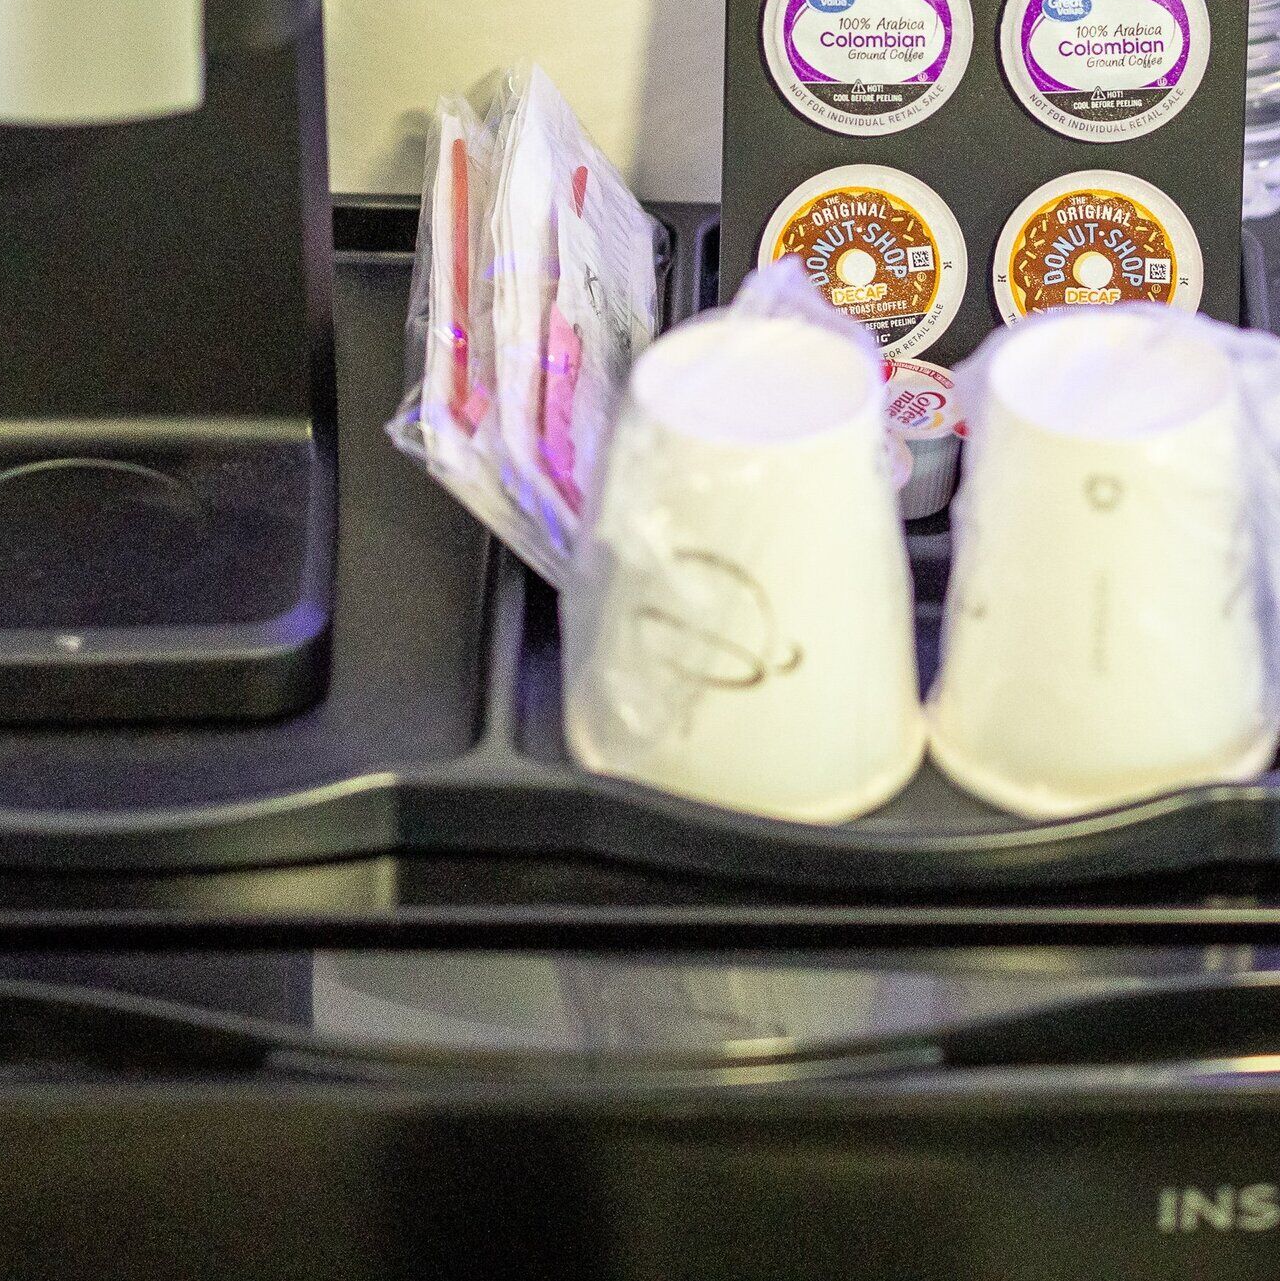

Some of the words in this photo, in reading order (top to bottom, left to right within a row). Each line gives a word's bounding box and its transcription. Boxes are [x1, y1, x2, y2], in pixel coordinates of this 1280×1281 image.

[1056, 5, 1085, 16] Value
[839, 17, 871, 30] 100%
[876, 17, 925, 30] Arabica
[1076, 25, 1108, 38] 100%
[1114, 23, 1162, 37] Arabica
[820, 31, 926, 48] Colombian
[848, 48, 886, 60] Ground
[889, 48, 924, 62] Coffee
[1058, 39, 1164, 57] Colombian
[1086, 56, 1125, 68] Ground
[1128, 54, 1163, 69] Coffee
[867, 84, 884, 92] HOT!
[1106, 90, 1124, 98] HOT!
[789, 83, 806, 102] NOT
[807, 100, 825, 117] FOR
[827, 111, 885, 127] INDIVIDUAL
[888, 105, 923, 124] RETAIL
[833, 94, 850, 102] COOL
[851, 94, 875, 102] BEFORE
[876, 93, 903, 102] PEELING
[1073, 101, 1090, 109] COOL
[1091, 100, 1115, 109] BEFORE
[1116, 98, 1143, 108] PEELING
[1029, 93, 1046, 112] NOT
[1047, 108, 1065, 126] FOR
[1068, 119, 1126, 134] INDIVIDUAL
[1129, 110, 1163, 129] RETAIL
[824, 195, 840, 205] THE
[1071, 196, 1086, 205] THE
[811, 202, 887, 227] ORIGINAL
[1056, 204, 1131, 227] ORIGINAL
[833, 284, 887, 304] DECAF
[1066, 289, 1120, 304] DECAF
[850, 304, 875, 315] ROAST
[877, 301, 908, 312] COFFEE
[865, 320, 889, 331] BEFORE
[890, 317, 917, 328] PEELING
[883, 348, 901, 360] FOR
[904, 327, 930, 350] RETAIL
[928, 303, 945, 326] SALE
[885, 390, 915, 419] mate
[897, 391, 947, 424] Coffee
